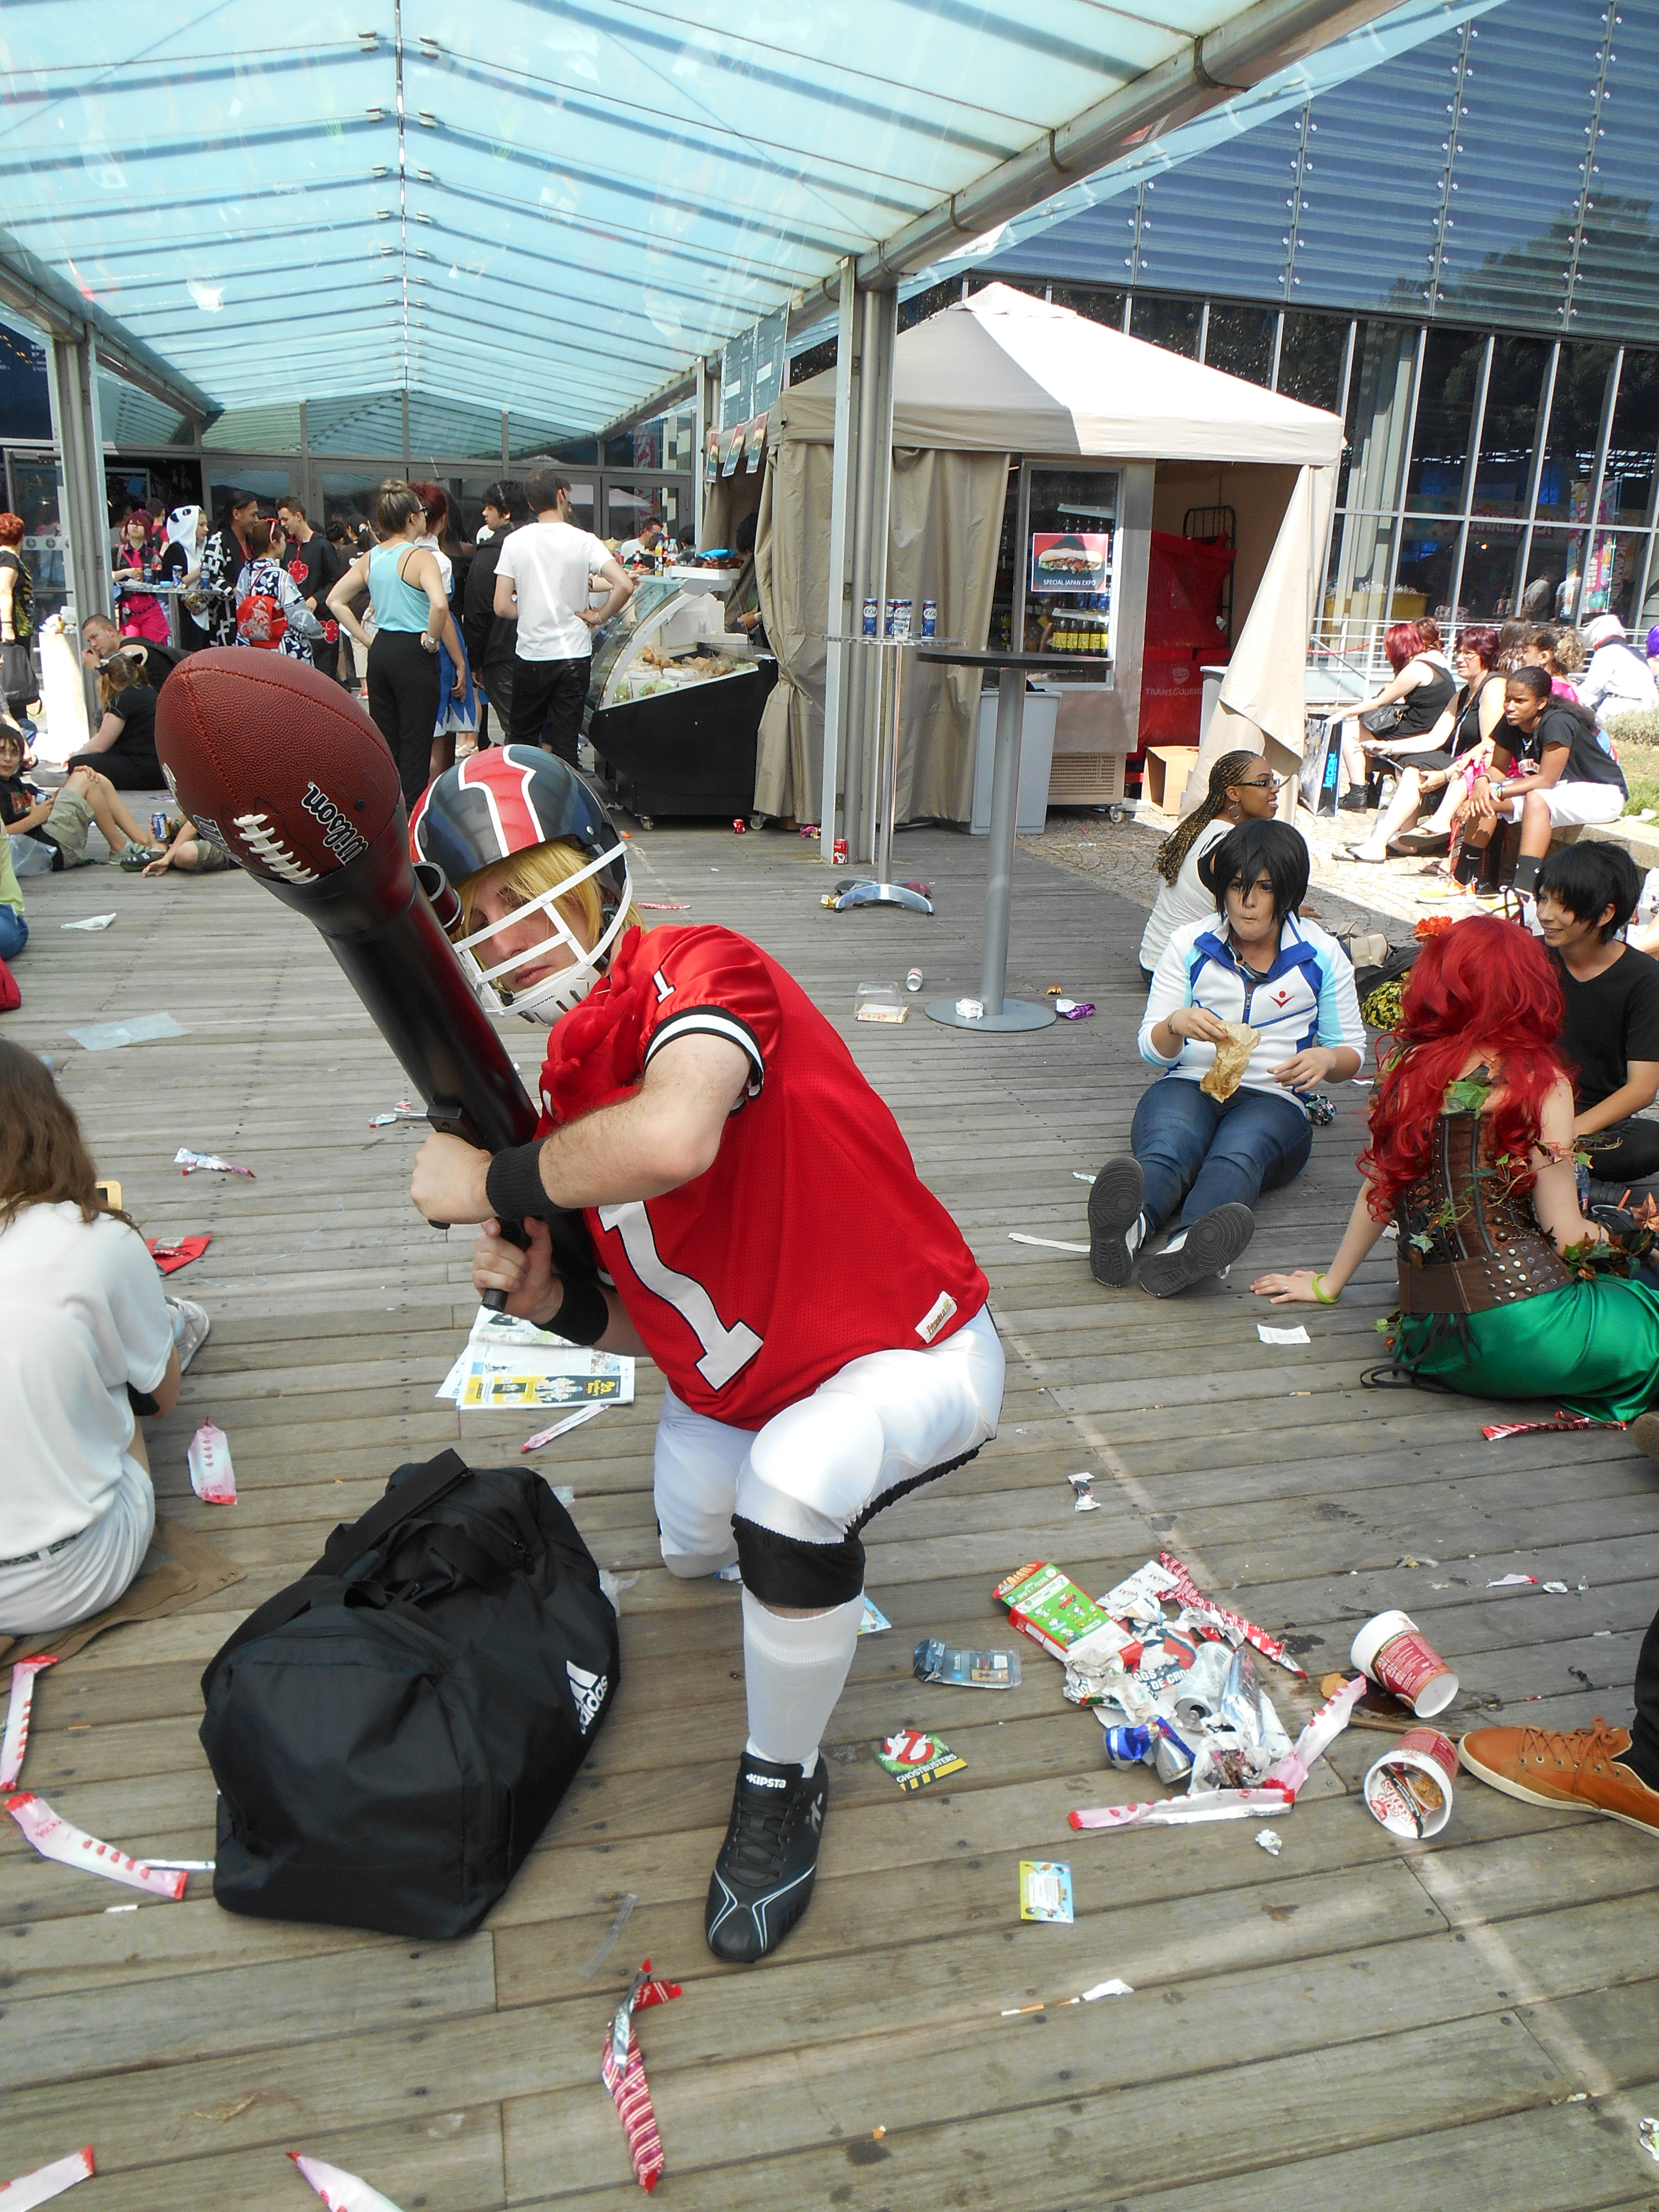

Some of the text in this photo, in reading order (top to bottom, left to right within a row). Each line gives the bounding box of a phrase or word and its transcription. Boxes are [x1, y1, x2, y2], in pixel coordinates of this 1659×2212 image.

[301, 781, 369, 866] Wilson
[598, 1201, 764, 1391] 1
[575, 1675, 608, 1735] adidas
[1152, 1677, 1166, 1691] DE
[896, 1753, 957, 1783] GHOSTBUSTERS
[1378, 1793, 1399, 1817] CUP
[1381, 1778, 1417, 1824] NOODLES
